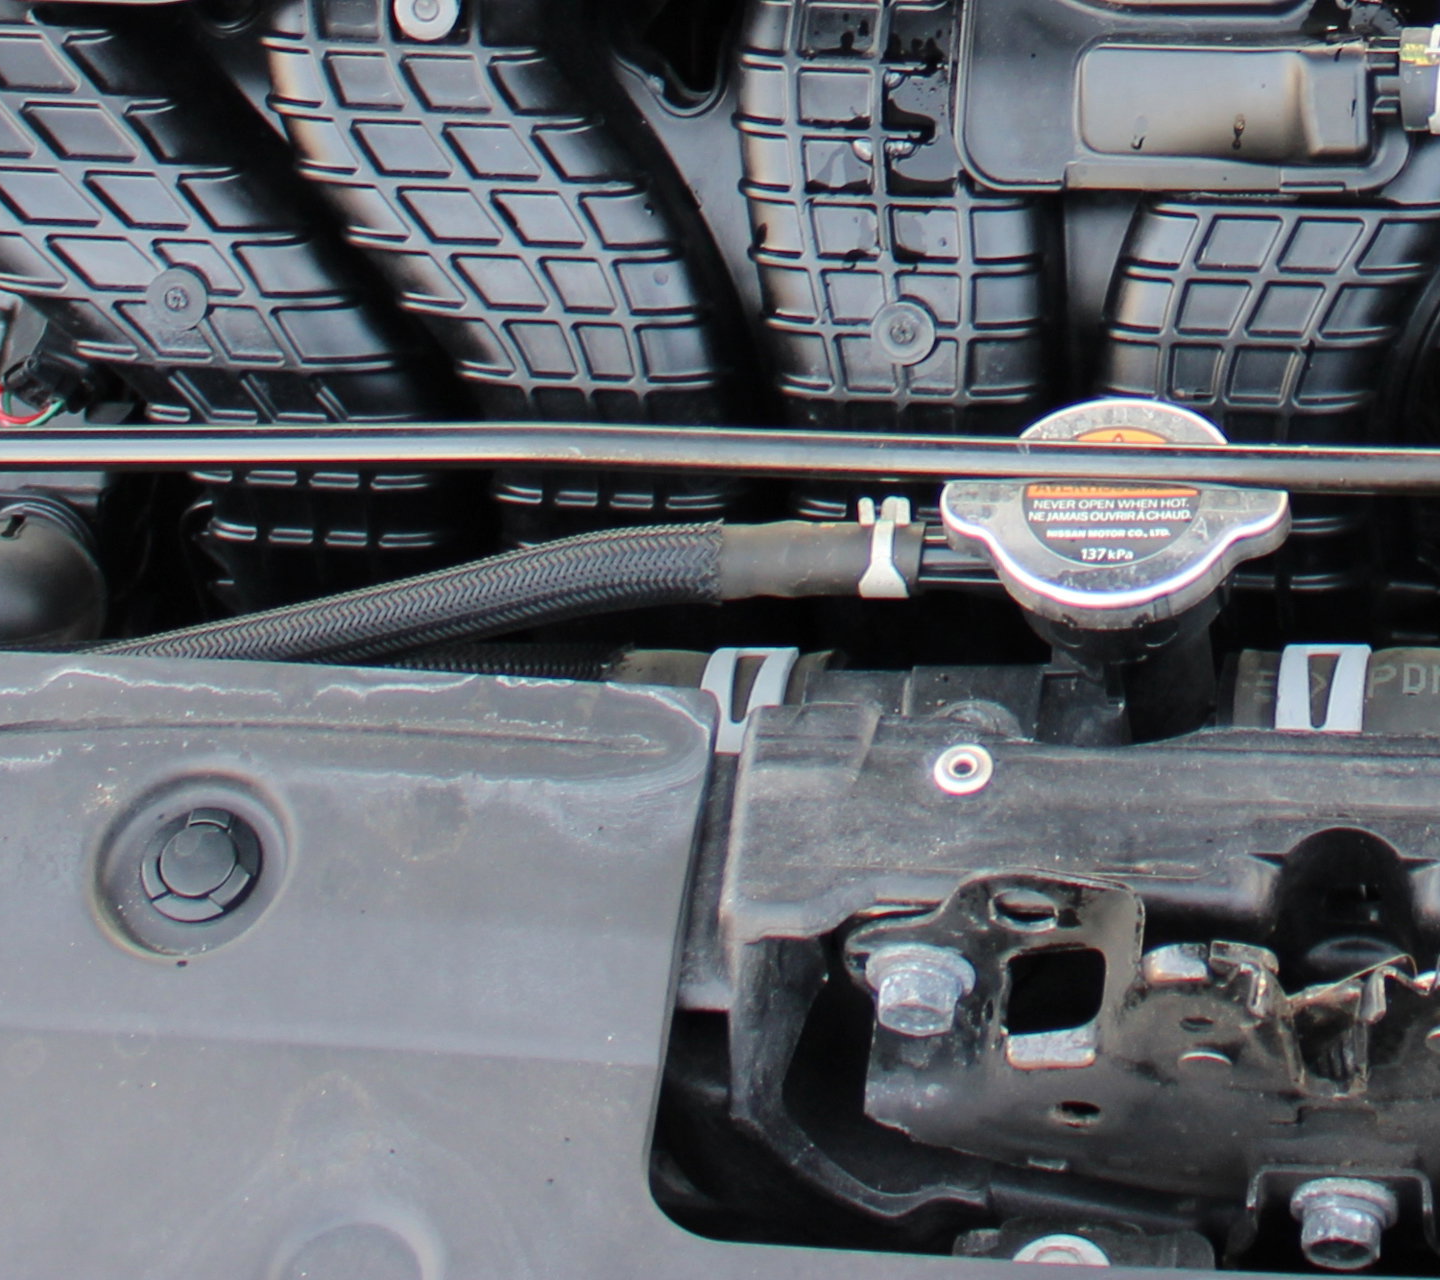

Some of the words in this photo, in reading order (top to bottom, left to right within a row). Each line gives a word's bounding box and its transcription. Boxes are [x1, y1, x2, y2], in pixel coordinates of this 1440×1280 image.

[1033, 499, 1076, 509] NEVER
[1078, 499, 1115, 509] OPEN
[1117, 498, 1158, 509] WHEN
[1160, 497, 1190, 508] HOT.
[1028, 511, 1045, 521] NE
[1046, 511, 1088, 522] JAMAIS
[1090, 510, 1136, 521] OUVRIR
[1046, 529, 1086, 538] NISSAN
[1088, 529, 1126, 538] MOTOR
[1081, 547, 1107, 560] 137
[1108, 548, 1134, 560] kPa
